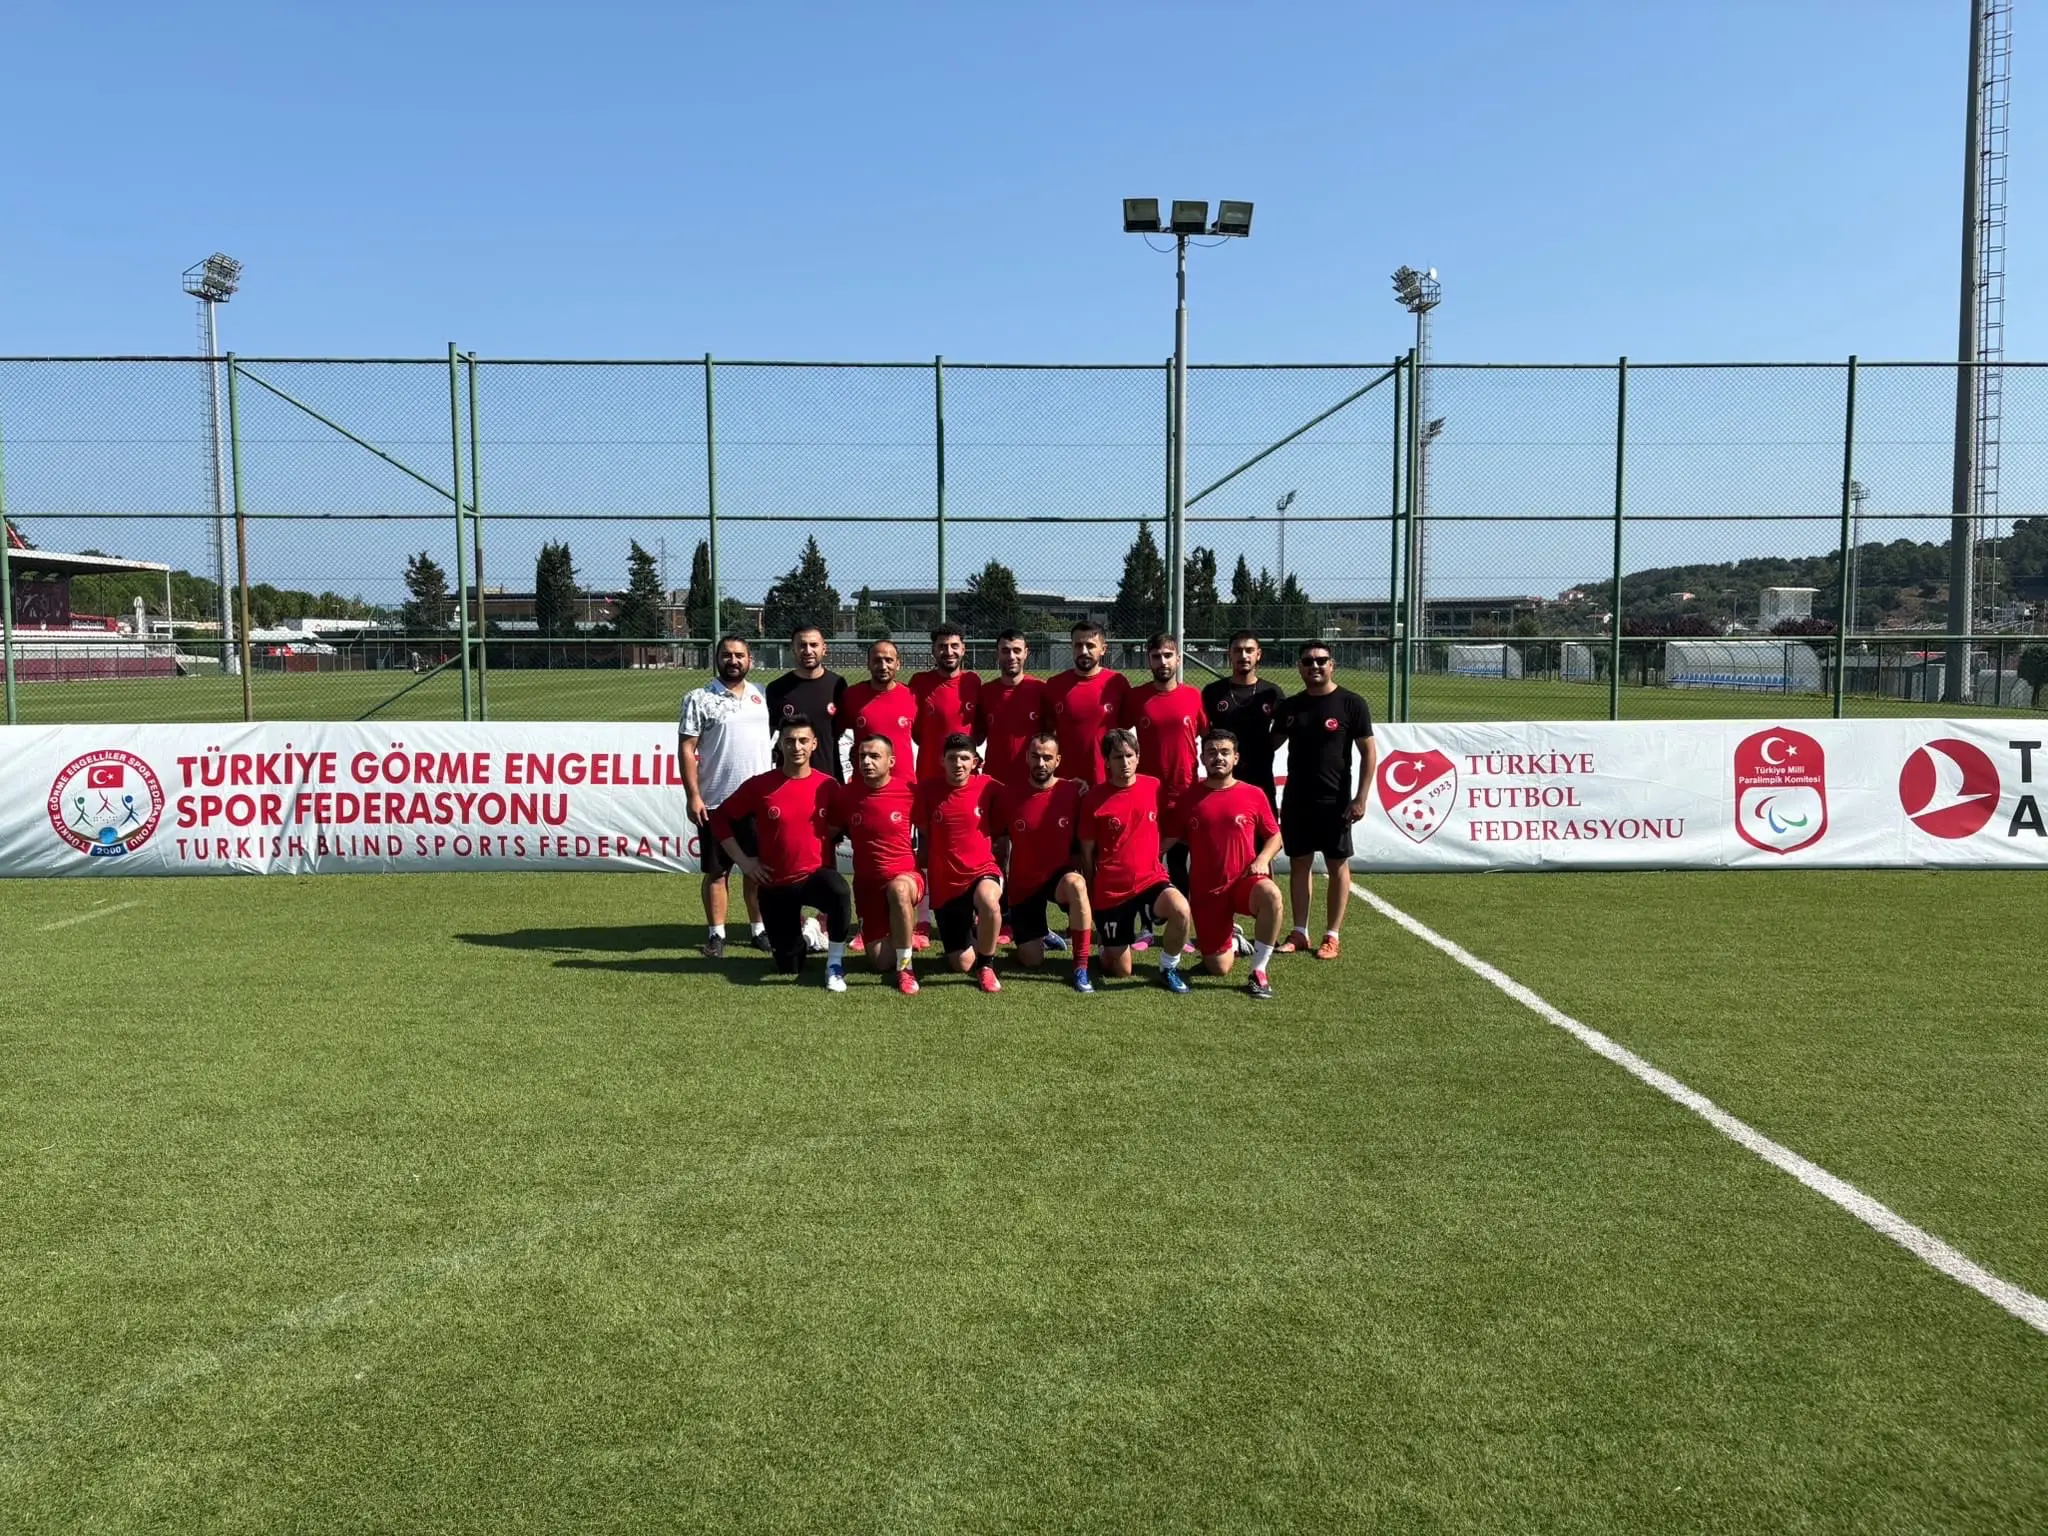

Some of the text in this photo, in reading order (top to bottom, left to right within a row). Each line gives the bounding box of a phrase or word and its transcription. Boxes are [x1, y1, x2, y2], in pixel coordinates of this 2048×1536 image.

[66, 751, 126, 776] ENGELLİLER
[127, 757, 151, 781] SPOR
[177, 742, 702, 787] TÜRKİYE GÖRME ENGELLİL
[1465, 748, 1595, 775] TÜRKİYE
[1754, 765, 1805, 775] Türkiye Milli
[1428, 781, 1452, 799] 1923
[1738, 775, 1821, 785] Paralimpik Komitesi
[49, 776, 69, 812] GÖRME
[1467, 786, 1582, 808] FUTBOL
[131, 780, 162, 847] FEDERASYONU
[177, 792, 568, 828] SPOR FEDERASYONU
[1469, 818, 1684, 841] FEDERASYONU
[96, 847, 121, 855] 2000
[177, 835, 701, 860] TURKISH BLIND SPORTS FEDERATIO
[1104, 921, 1117, 938] 17
